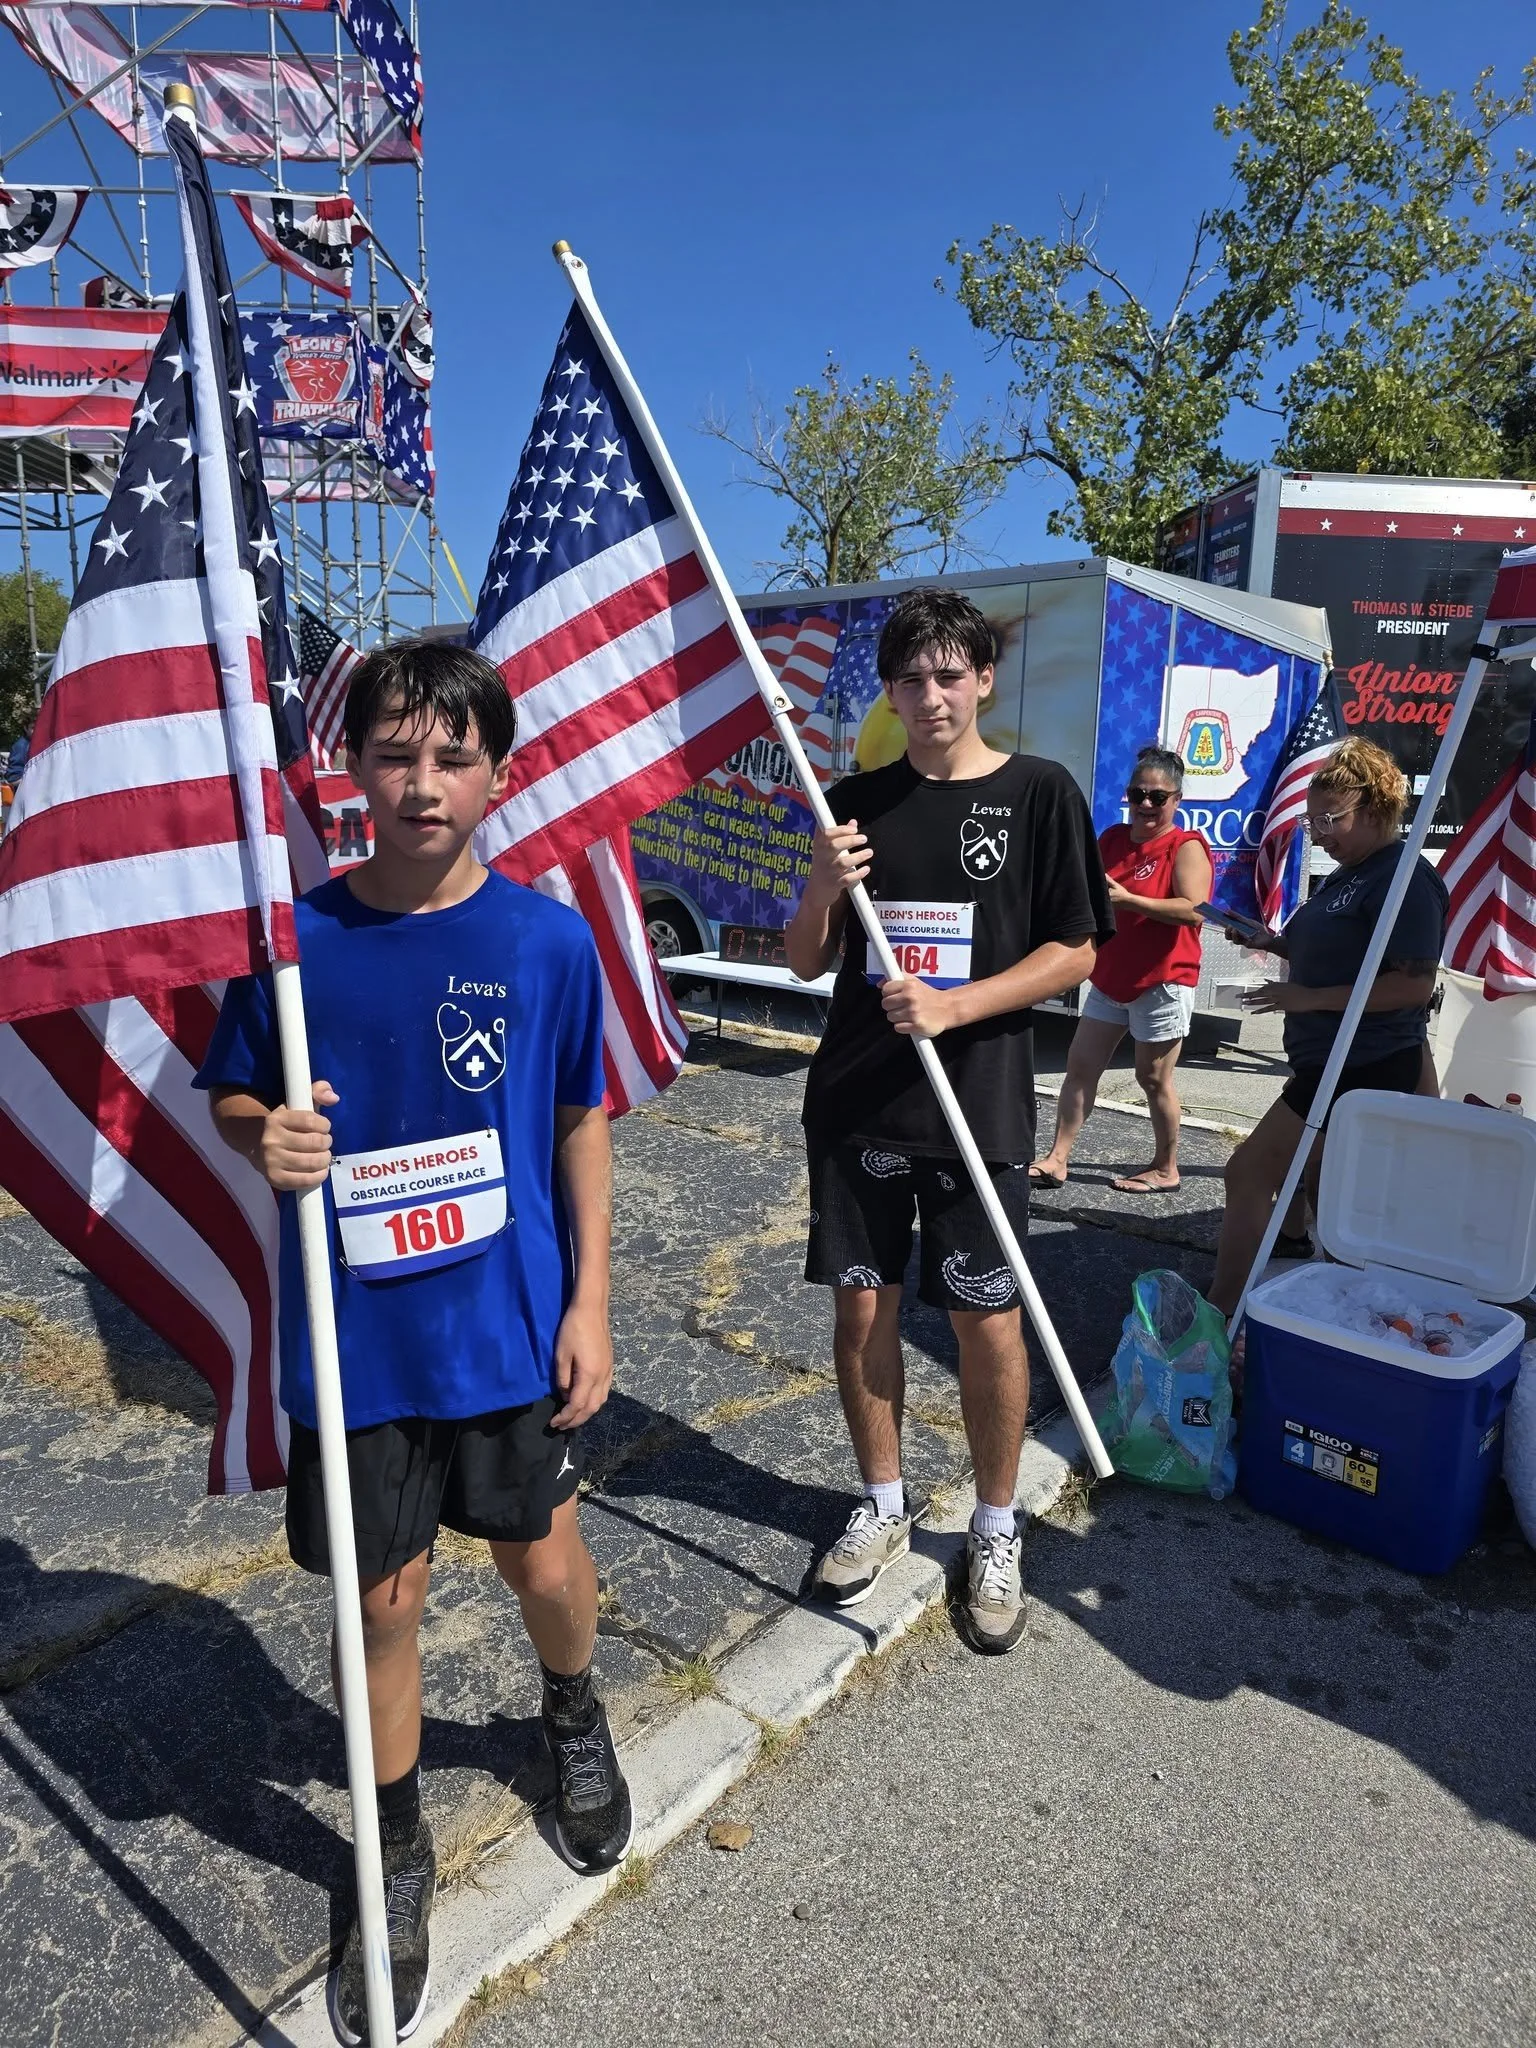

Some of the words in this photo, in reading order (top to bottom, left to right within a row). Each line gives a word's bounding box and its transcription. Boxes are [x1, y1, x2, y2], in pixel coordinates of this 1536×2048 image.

[292, 338, 344, 353] LEON'S
[275, 402, 358, 421] TRIATHLON
[1352, 600, 1407, 616] THOMAS
[1411, 603, 1425, 616] W.
[1428, 603, 1473, 618] STIEDE
[1377, 620, 1450, 636] PRESIDENT
[1348, 660, 1457, 695] Union
[1342, 688, 1455, 737] Strong
[712, 786, 739, 810] make
[741, 797, 766, 815] sure
[769, 804, 788, 822] our
[970, 802, 1012, 817] Leva's
[704, 811, 726, 830] earn
[729, 815, 765, 846] wages,
[768, 825, 813, 855] benefits
[1435, 825, 1454, 834] LOCAL
[660, 818, 681, 842] they
[728, 837, 737, 857] in
[740, 845, 791, 873] exchange
[631, 834, 682, 865] roductivity
[684, 847, 706, 873] they
[708, 856, 737, 882] bring
[738, 864, 749, 885] to
[751, 867, 771, 890] the
[880, 909, 913, 920] LEON'S
[916, 911, 958, 921] HEROES
[883, 925, 909, 933] BSTACLE
[892, 944, 939, 975] 164
[447, 975, 507, 998] Leva's
[352, 1160, 410, 1181] LEON'S
[413, 1146, 478, 1170] HEROES
[350, 1183, 407, 1201] OBSTACLE
[409, 1174, 455, 1191] COURSE
[457, 1167, 486, 1181] RACE
[384, 1202, 465, 1256] 160
[1290, 1443, 1305, 1458] 4
[1309, 1429, 1353, 1452] IGLOO
[1348, 1460, 1366, 1474] 60
